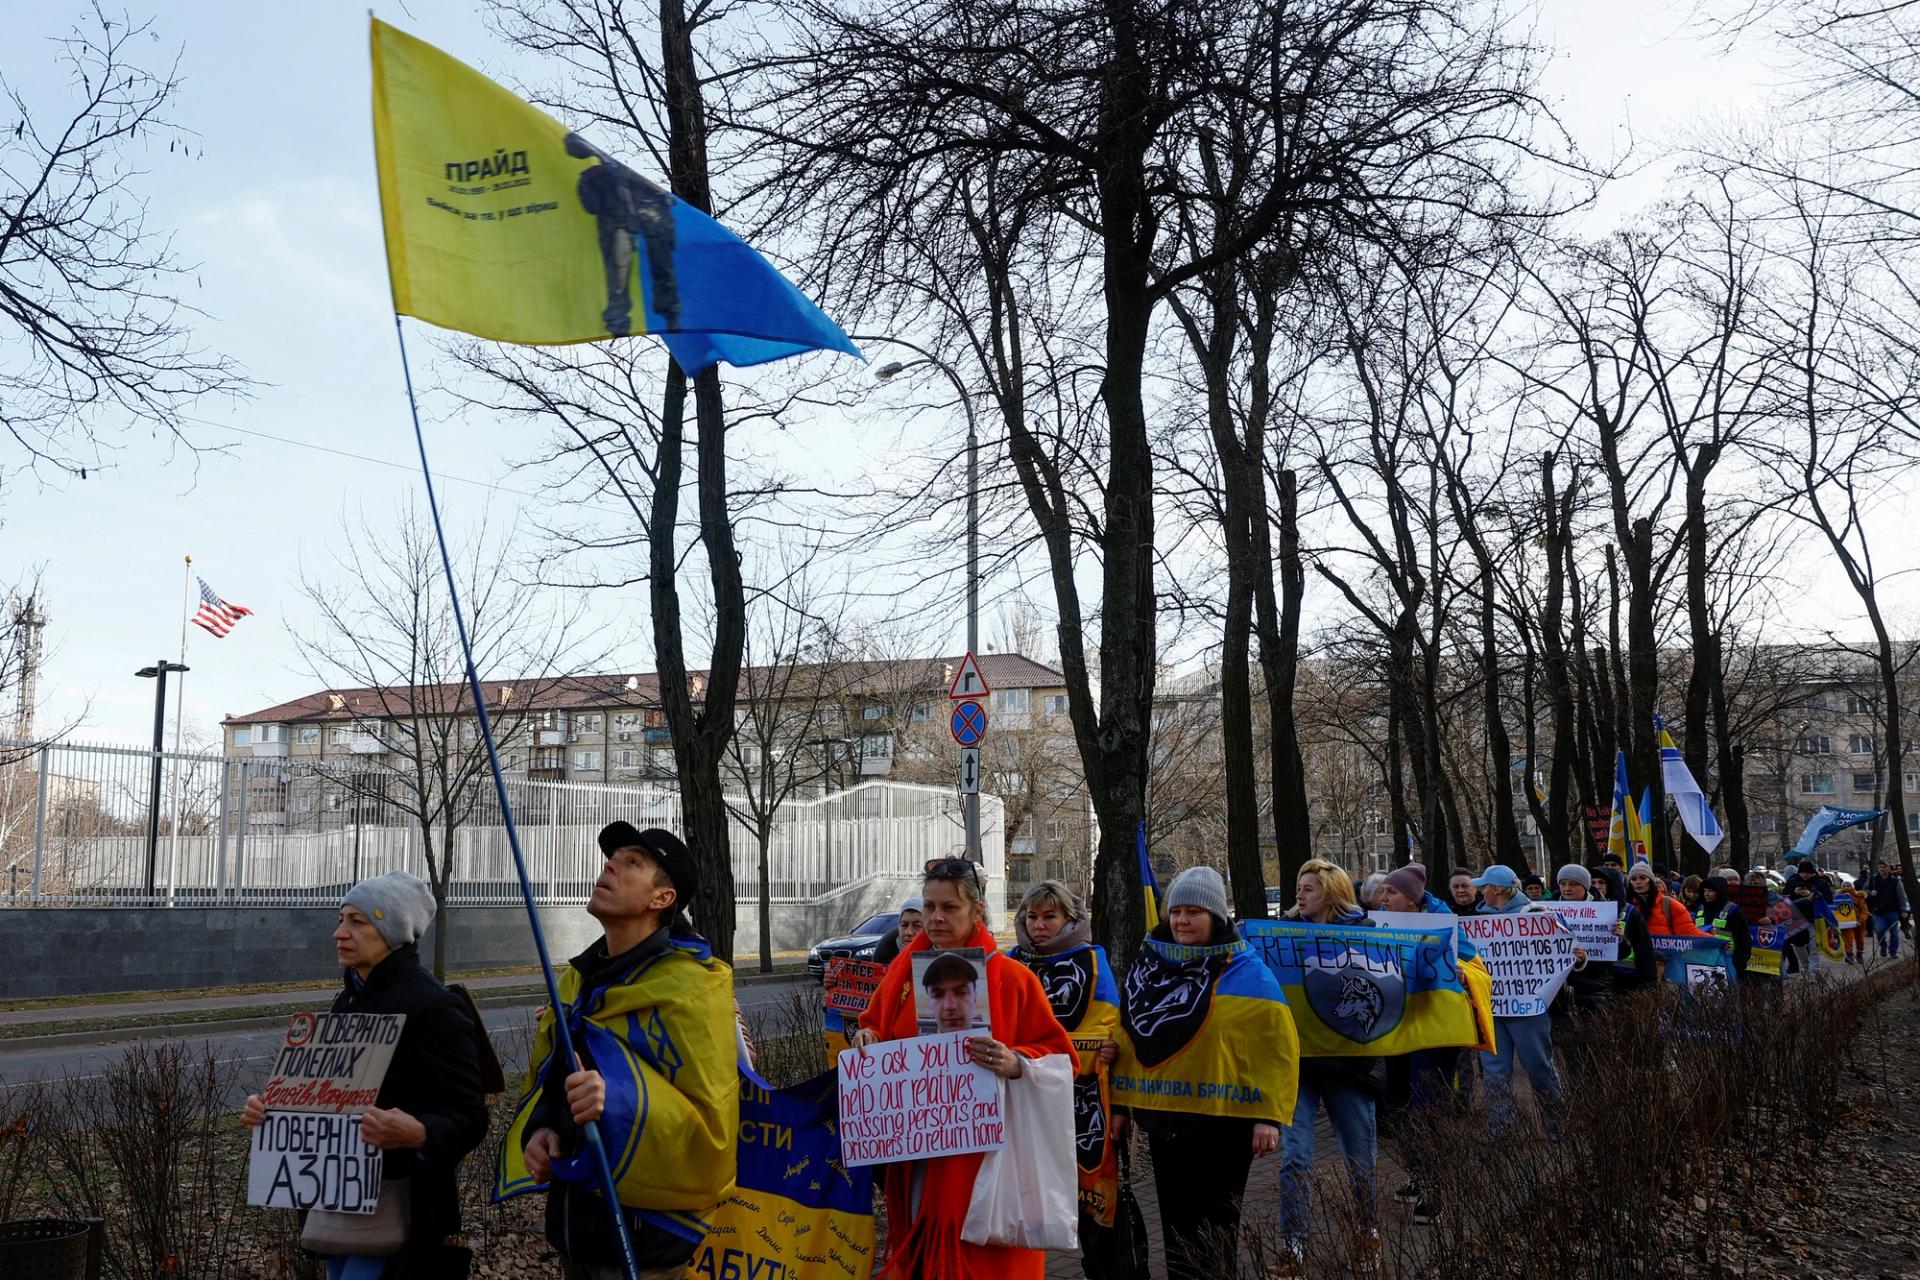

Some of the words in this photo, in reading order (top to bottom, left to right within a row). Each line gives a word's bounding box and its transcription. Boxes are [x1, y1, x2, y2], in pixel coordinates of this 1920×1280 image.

[445, 147, 530, 182] ПРАЙД
[1580, 907, 1597, 919] Kills.
[1458, 917, 1513, 939] КАЄМО
[1517, 916, 1567, 937] ВДОМ
[1247, 935, 1311, 968] FREE
[1316, 936, 1457, 982] EDELWEISS
[1530, 939, 1552, 956] 106
[1553, 938, 1574, 954] 107
[1584, 947, 1605, 958] ytsky.
[845, 963, 873, 978] FREE
[1535, 959, 1555, 974] 113
[856, 981, 879, 993] TAN
[1491, 980, 1504, 996] 20
[1505, 979, 1524, 995] 119
[832, 992, 870, 1009] BRIGA
[310, 1013, 399, 1045] ПОВЕРНІТЬ
[275, 1046, 365, 1079] ПОЛЕГЛИХ
[840, 1054, 875, 1080] We
[882, 1042, 910, 1075] ask
[840, 1081, 875, 1119] help
[879, 1079, 907, 1111] our
[1137, 1080, 1192, 1098] АНКОВА
[1197, 1083, 1262, 1104] БРИГАДА
[841, 1112, 905, 1139] missing
[908, 1101, 970, 1132] persons
[972, 1093, 999, 1119] and
[740, 1119, 793, 1151] СТИ
[907, 1131, 923, 1155] to
[927, 1126, 970, 1152] return
[972, 1119, 1004, 1147] home
[265, 1154, 381, 1213] АЗОВ!!!
[727, 1195, 761, 1213] тепан
[707, 1226, 737, 1237] гдан
[755, 1226, 783, 1253] Денис
[687, 1245, 787, 1280] АБУТ
